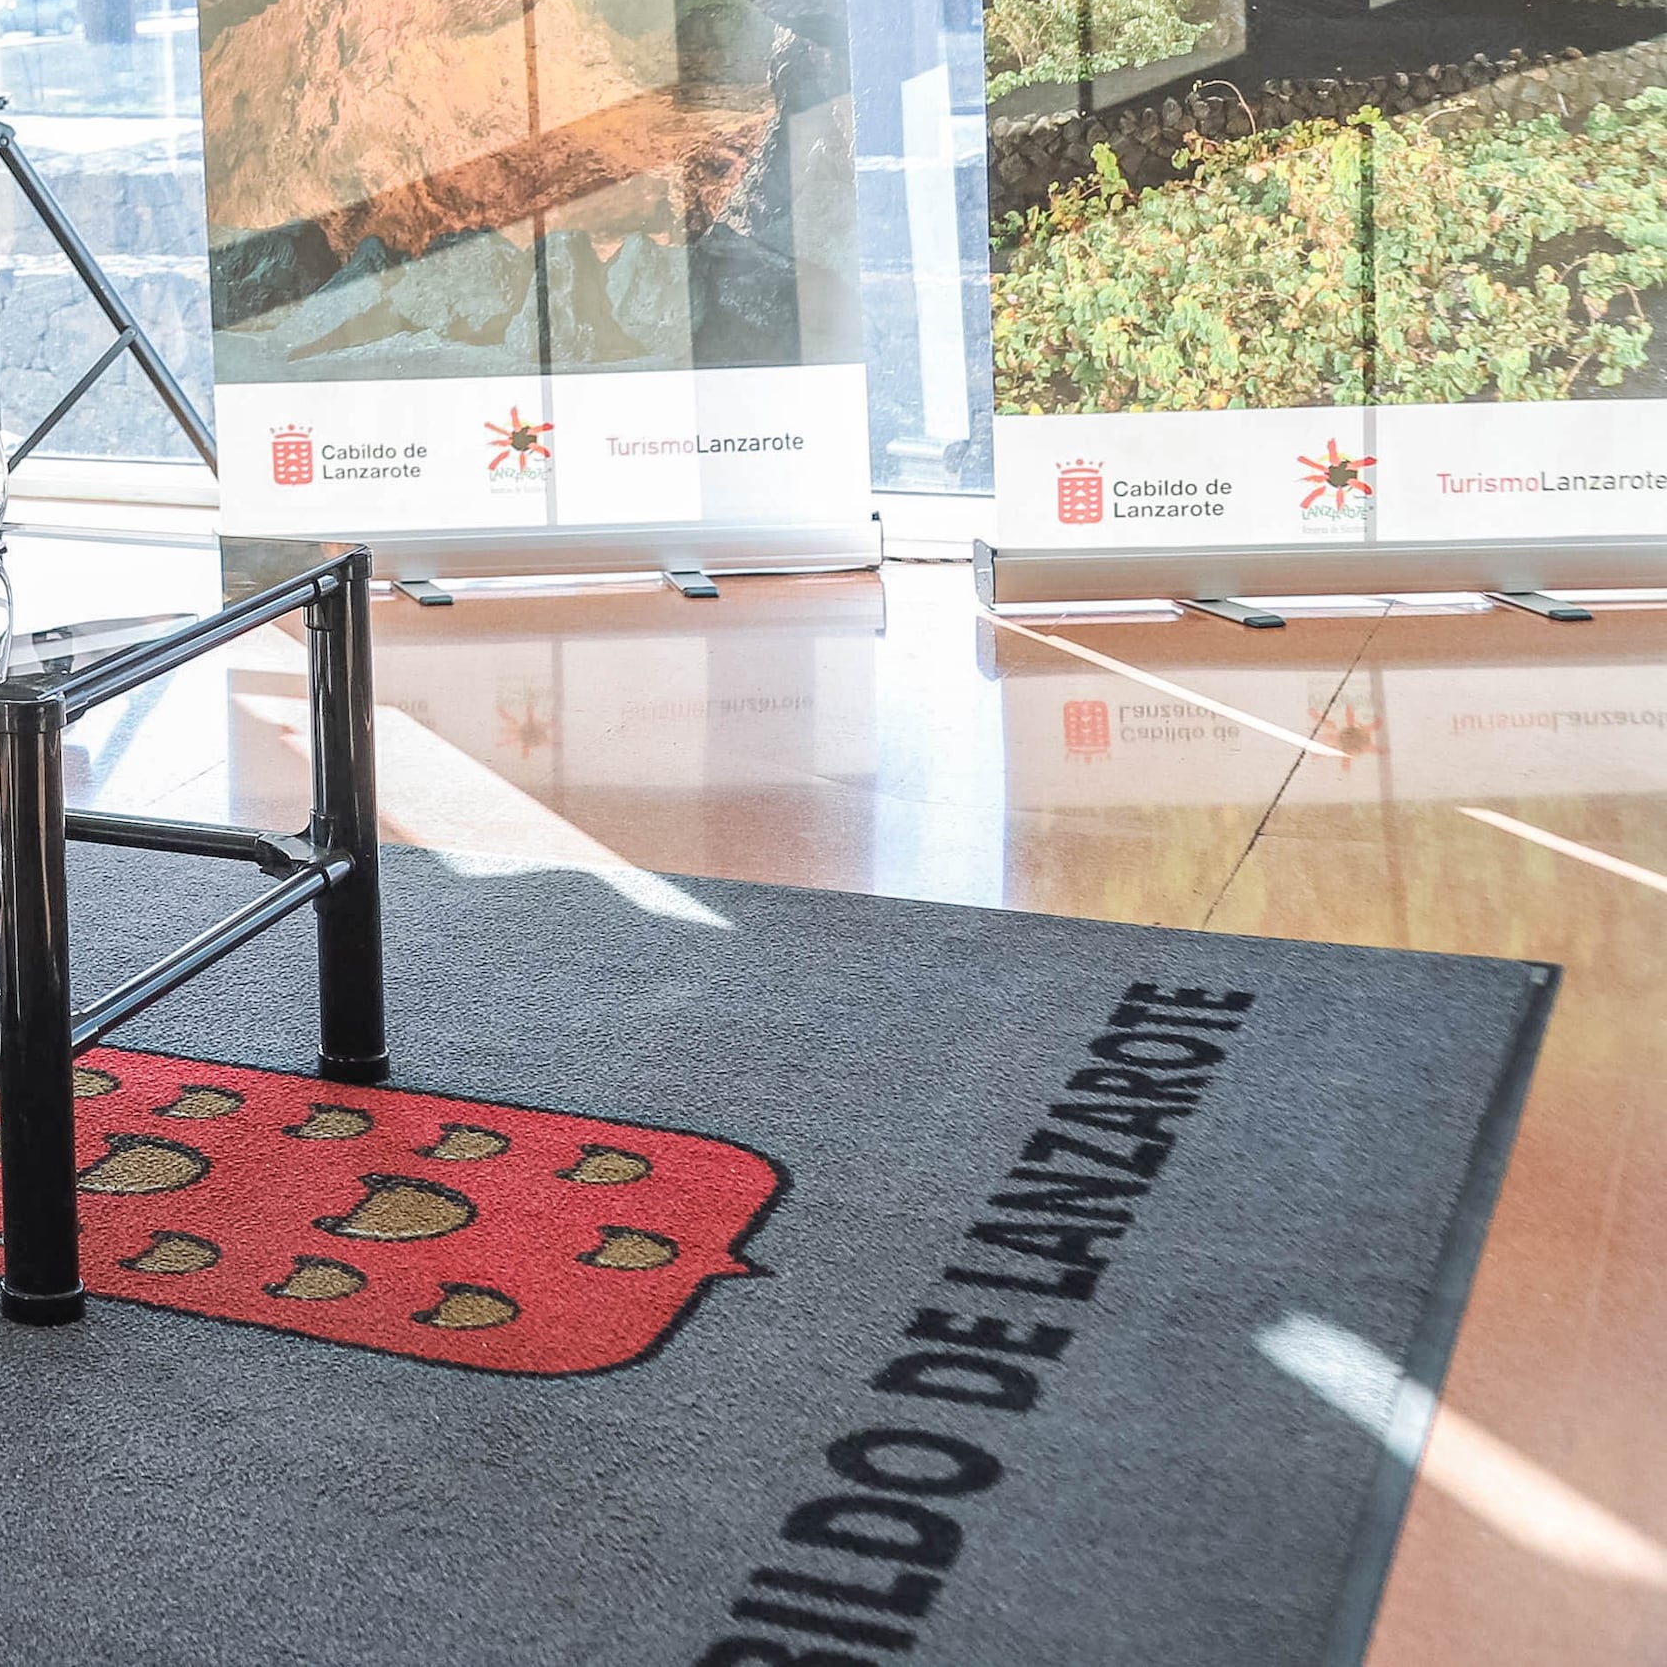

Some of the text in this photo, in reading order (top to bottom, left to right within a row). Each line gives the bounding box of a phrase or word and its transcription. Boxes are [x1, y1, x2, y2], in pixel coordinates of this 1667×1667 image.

[321, 442, 428, 461] Cabildo de
[605, 432, 805, 456] TurismoLanzarote
[322, 464, 421, 480] Lanzarote
[1436, 471, 1667, 494] TurismoLanzarote
[1113, 477, 1233, 498] Cabildo de
[1114, 500, 1225, 518] Lanzarote
[944, 980, 1257, 1301] LANZAROTE
[870, 1306, 1075, 1414] DE
